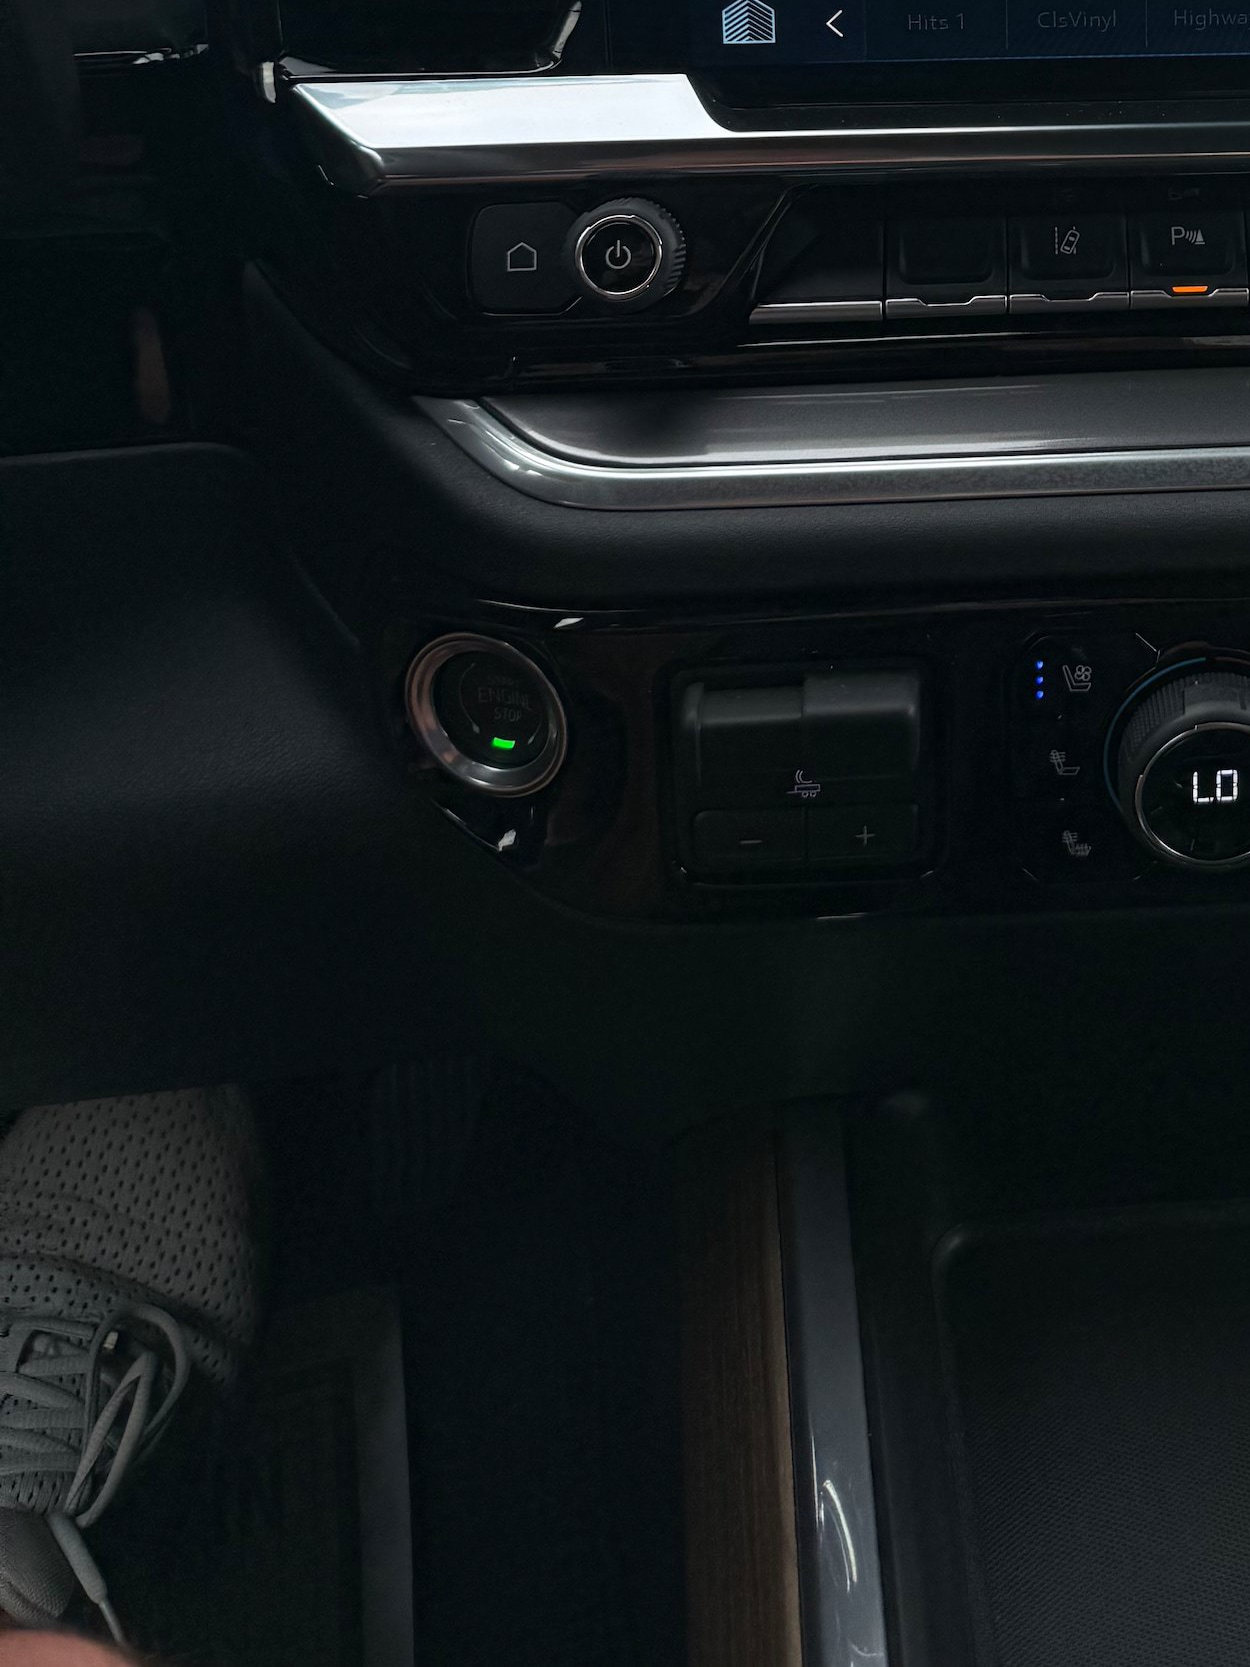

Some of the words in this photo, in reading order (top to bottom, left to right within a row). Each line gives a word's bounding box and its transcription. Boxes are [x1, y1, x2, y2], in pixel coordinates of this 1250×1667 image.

[908, 13, 949, 32] Hits
[957, 14, 965, 31] 1
[1037, 9, 1117, 33] ClsVinyl
